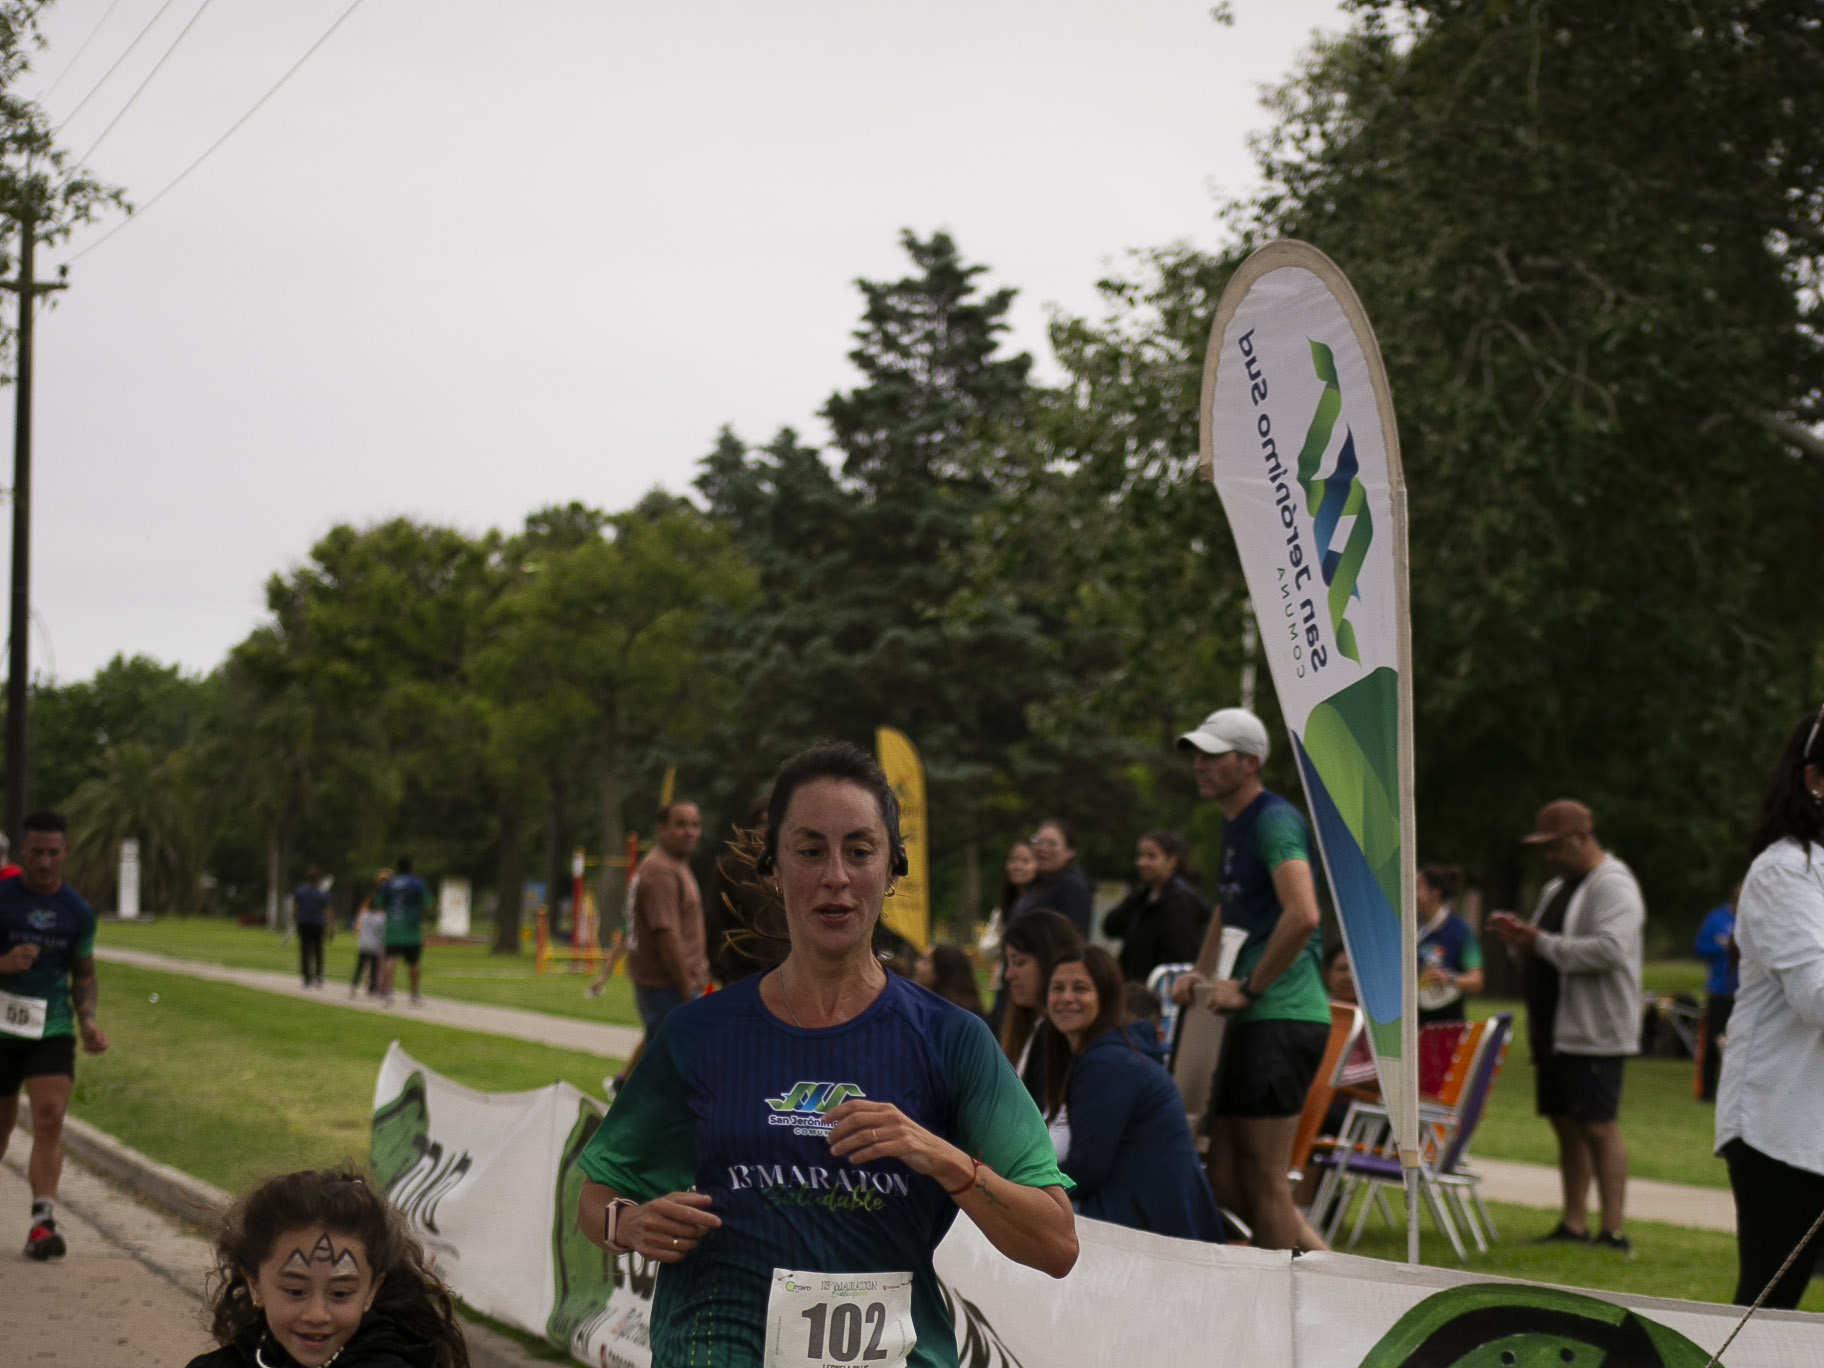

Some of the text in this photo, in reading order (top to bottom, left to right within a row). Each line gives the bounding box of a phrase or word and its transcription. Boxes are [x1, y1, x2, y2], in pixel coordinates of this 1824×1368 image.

[768, 1114, 790, 1126] San
[793, 1128, 830, 1138] COMUN
[756, 1165, 909, 1197] MARATON
[801, 1302, 888, 1362] 102
